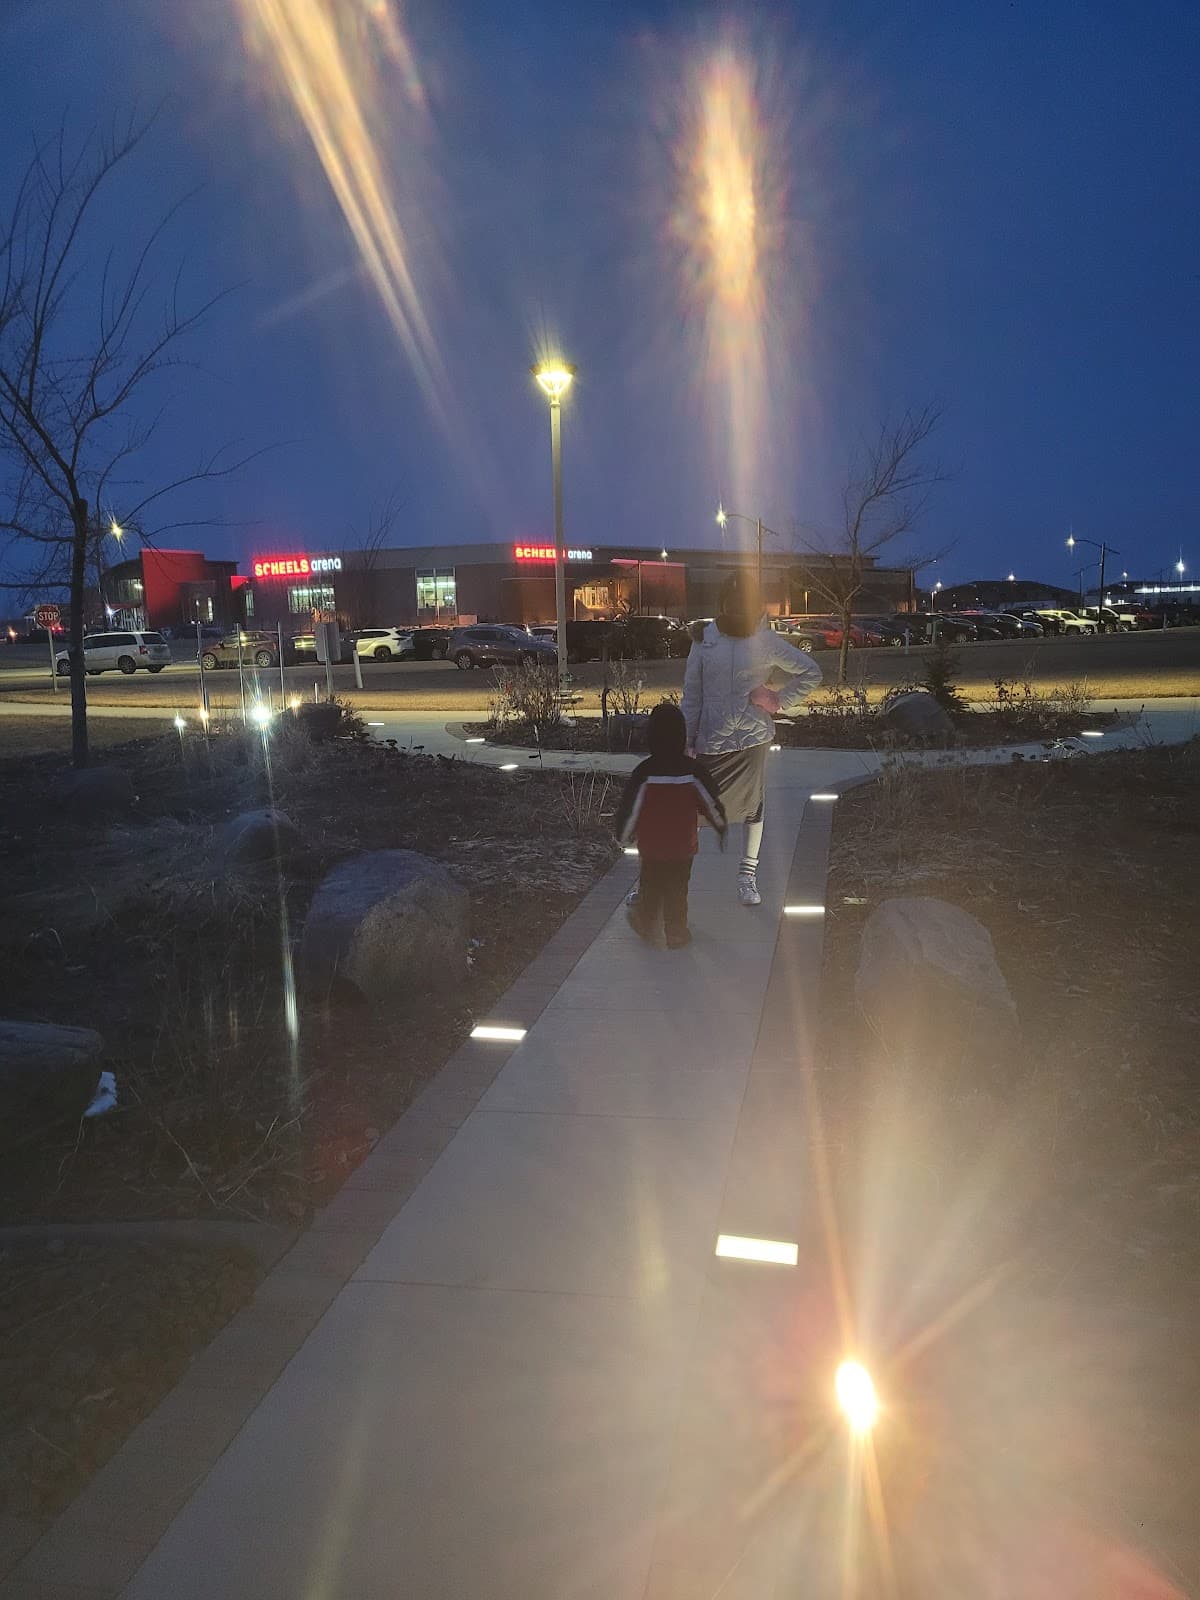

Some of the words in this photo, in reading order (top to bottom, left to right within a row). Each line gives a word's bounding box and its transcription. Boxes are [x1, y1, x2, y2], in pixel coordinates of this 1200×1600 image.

[567, 550, 592, 559] arena
[255, 559, 309, 576] SCHEELS
[311, 558, 341, 571] arena
[38, 611, 58, 621] STOP
